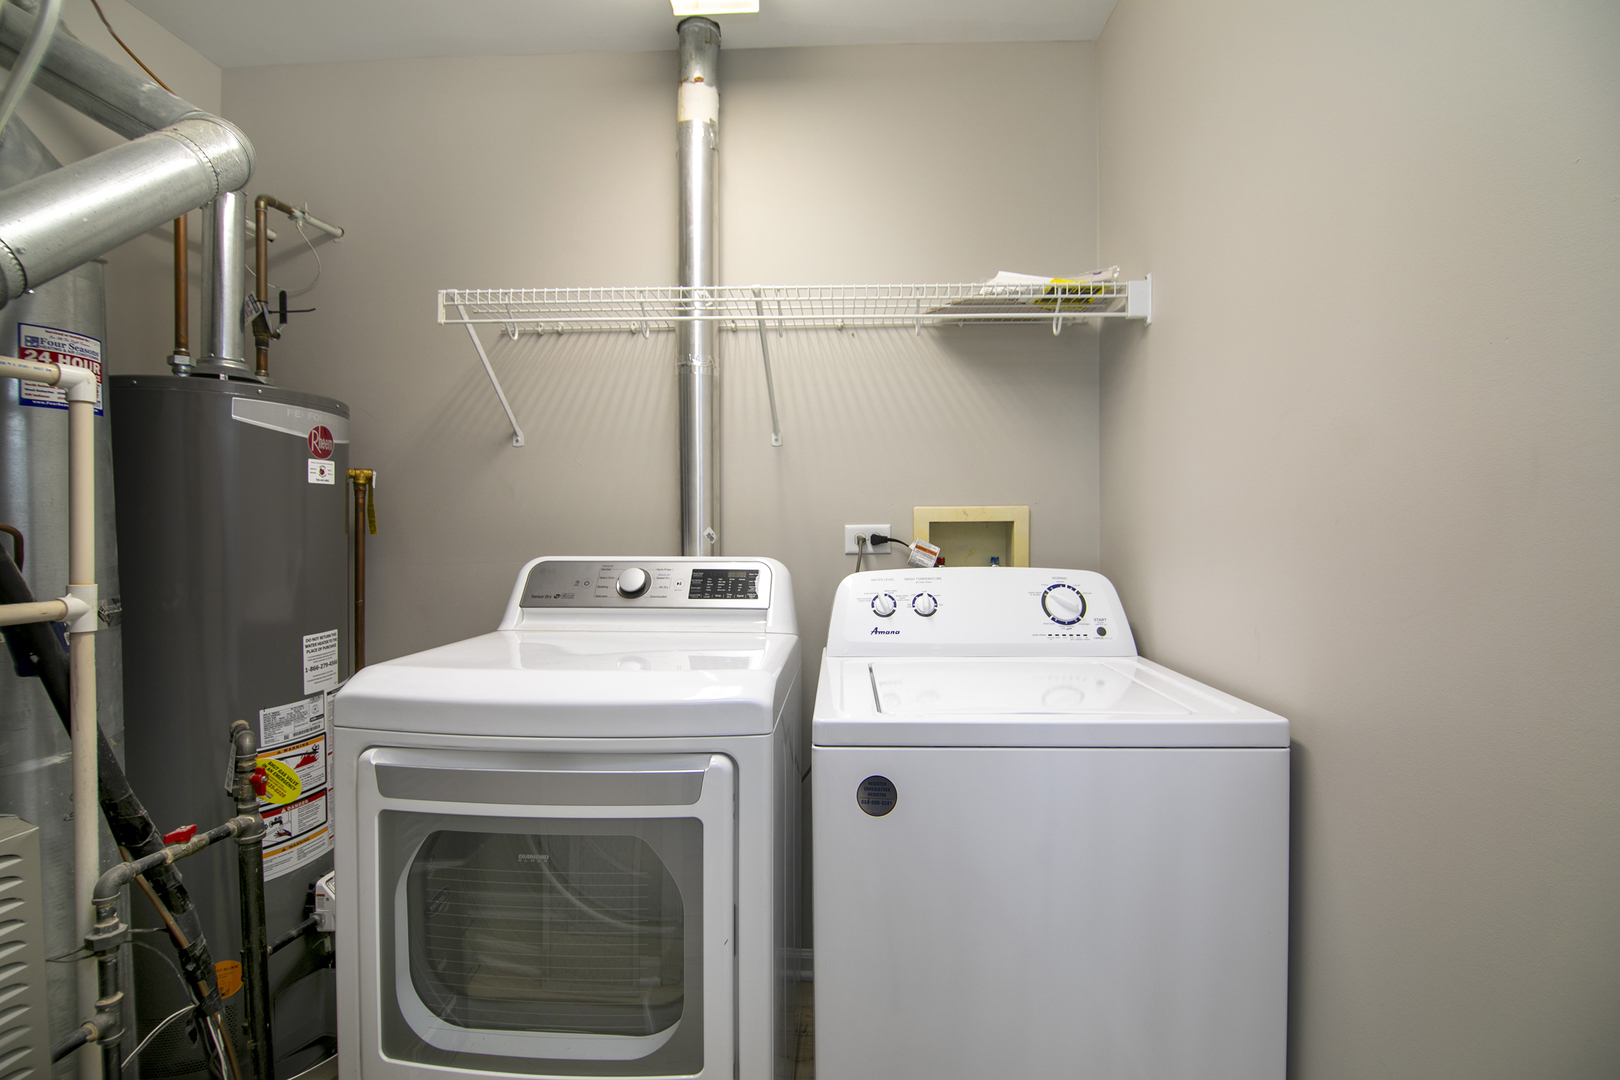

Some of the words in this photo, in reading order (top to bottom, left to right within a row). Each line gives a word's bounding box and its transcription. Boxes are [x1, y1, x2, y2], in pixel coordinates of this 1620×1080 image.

[40, 337, 67, 348] Four
[68, 343, 99, 357] Seasons
[24, 349, 52, 364] 24
[58, 353, 101, 375] HOUR
[311, 425, 333, 454] Rheem
[870, 626, 900, 635] Amana
[283, 742, 309, 752] WARNING
[267, 761, 280, 771] SHUT
[277, 769, 287, 777] GAS
[286, 775, 299, 786] VALVE
[272, 771, 297, 791] EMERGENCY
[287, 800, 309, 811] DANGER
[288, 837, 311, 849] WARNING
